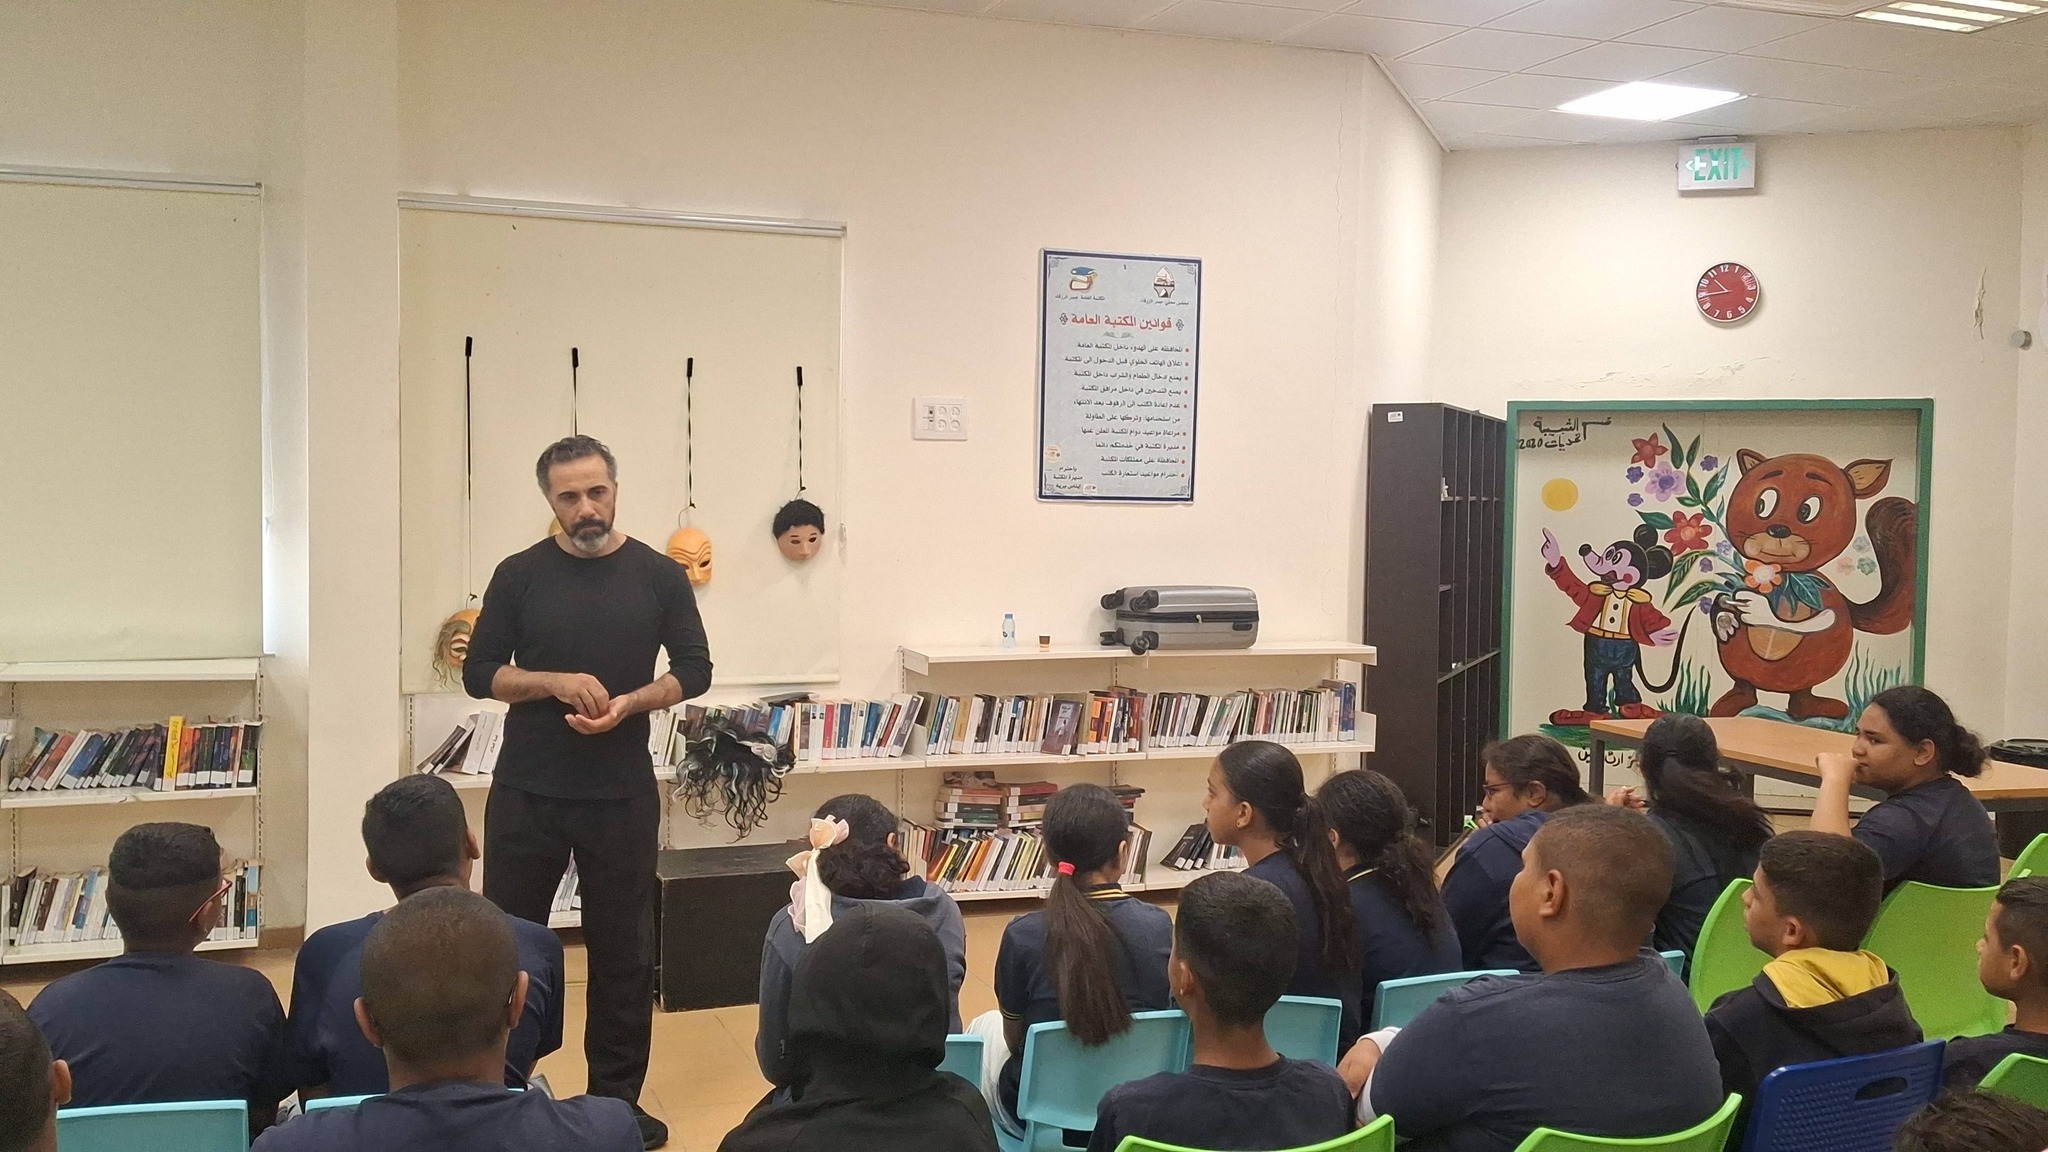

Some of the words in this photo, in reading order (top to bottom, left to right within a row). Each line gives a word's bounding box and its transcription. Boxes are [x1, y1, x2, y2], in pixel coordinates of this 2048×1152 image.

[1694, 148, 1744, 180] EXIT
[1708, 269, 1717, 278] 11
[1700, 279, 1709, 287] 10
[1071, 314, 1101, 325] العامة
[1104, 315, 1136, 328] المكتبة
[1139, 317, 1172, 331] قوانين
[1533, 416, 1578, 436] الشبيبة
[1582, 417, 1612, 440] قسم
[1518, 438, 1543, 449] 2020
